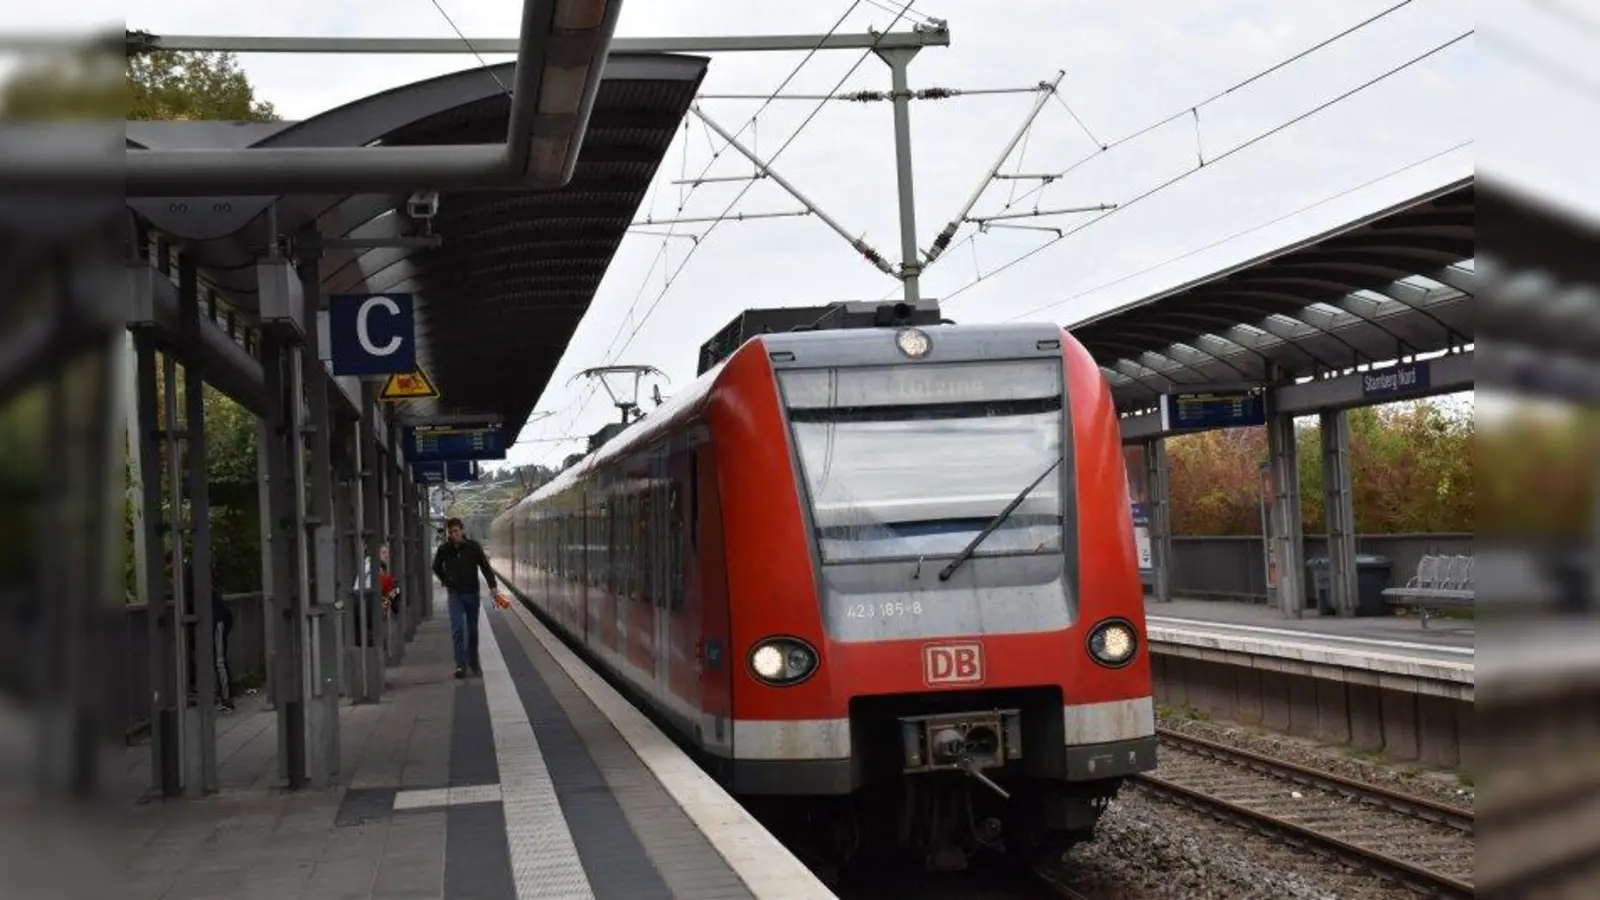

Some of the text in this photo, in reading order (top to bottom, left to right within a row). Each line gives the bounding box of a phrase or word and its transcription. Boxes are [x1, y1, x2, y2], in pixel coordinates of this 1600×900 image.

[356, 296, 403, 356] C
[1398, 367, 1416, 385] Nord
[846, 604, 875, 619] 423
[931, 649, 977, 678] DB
